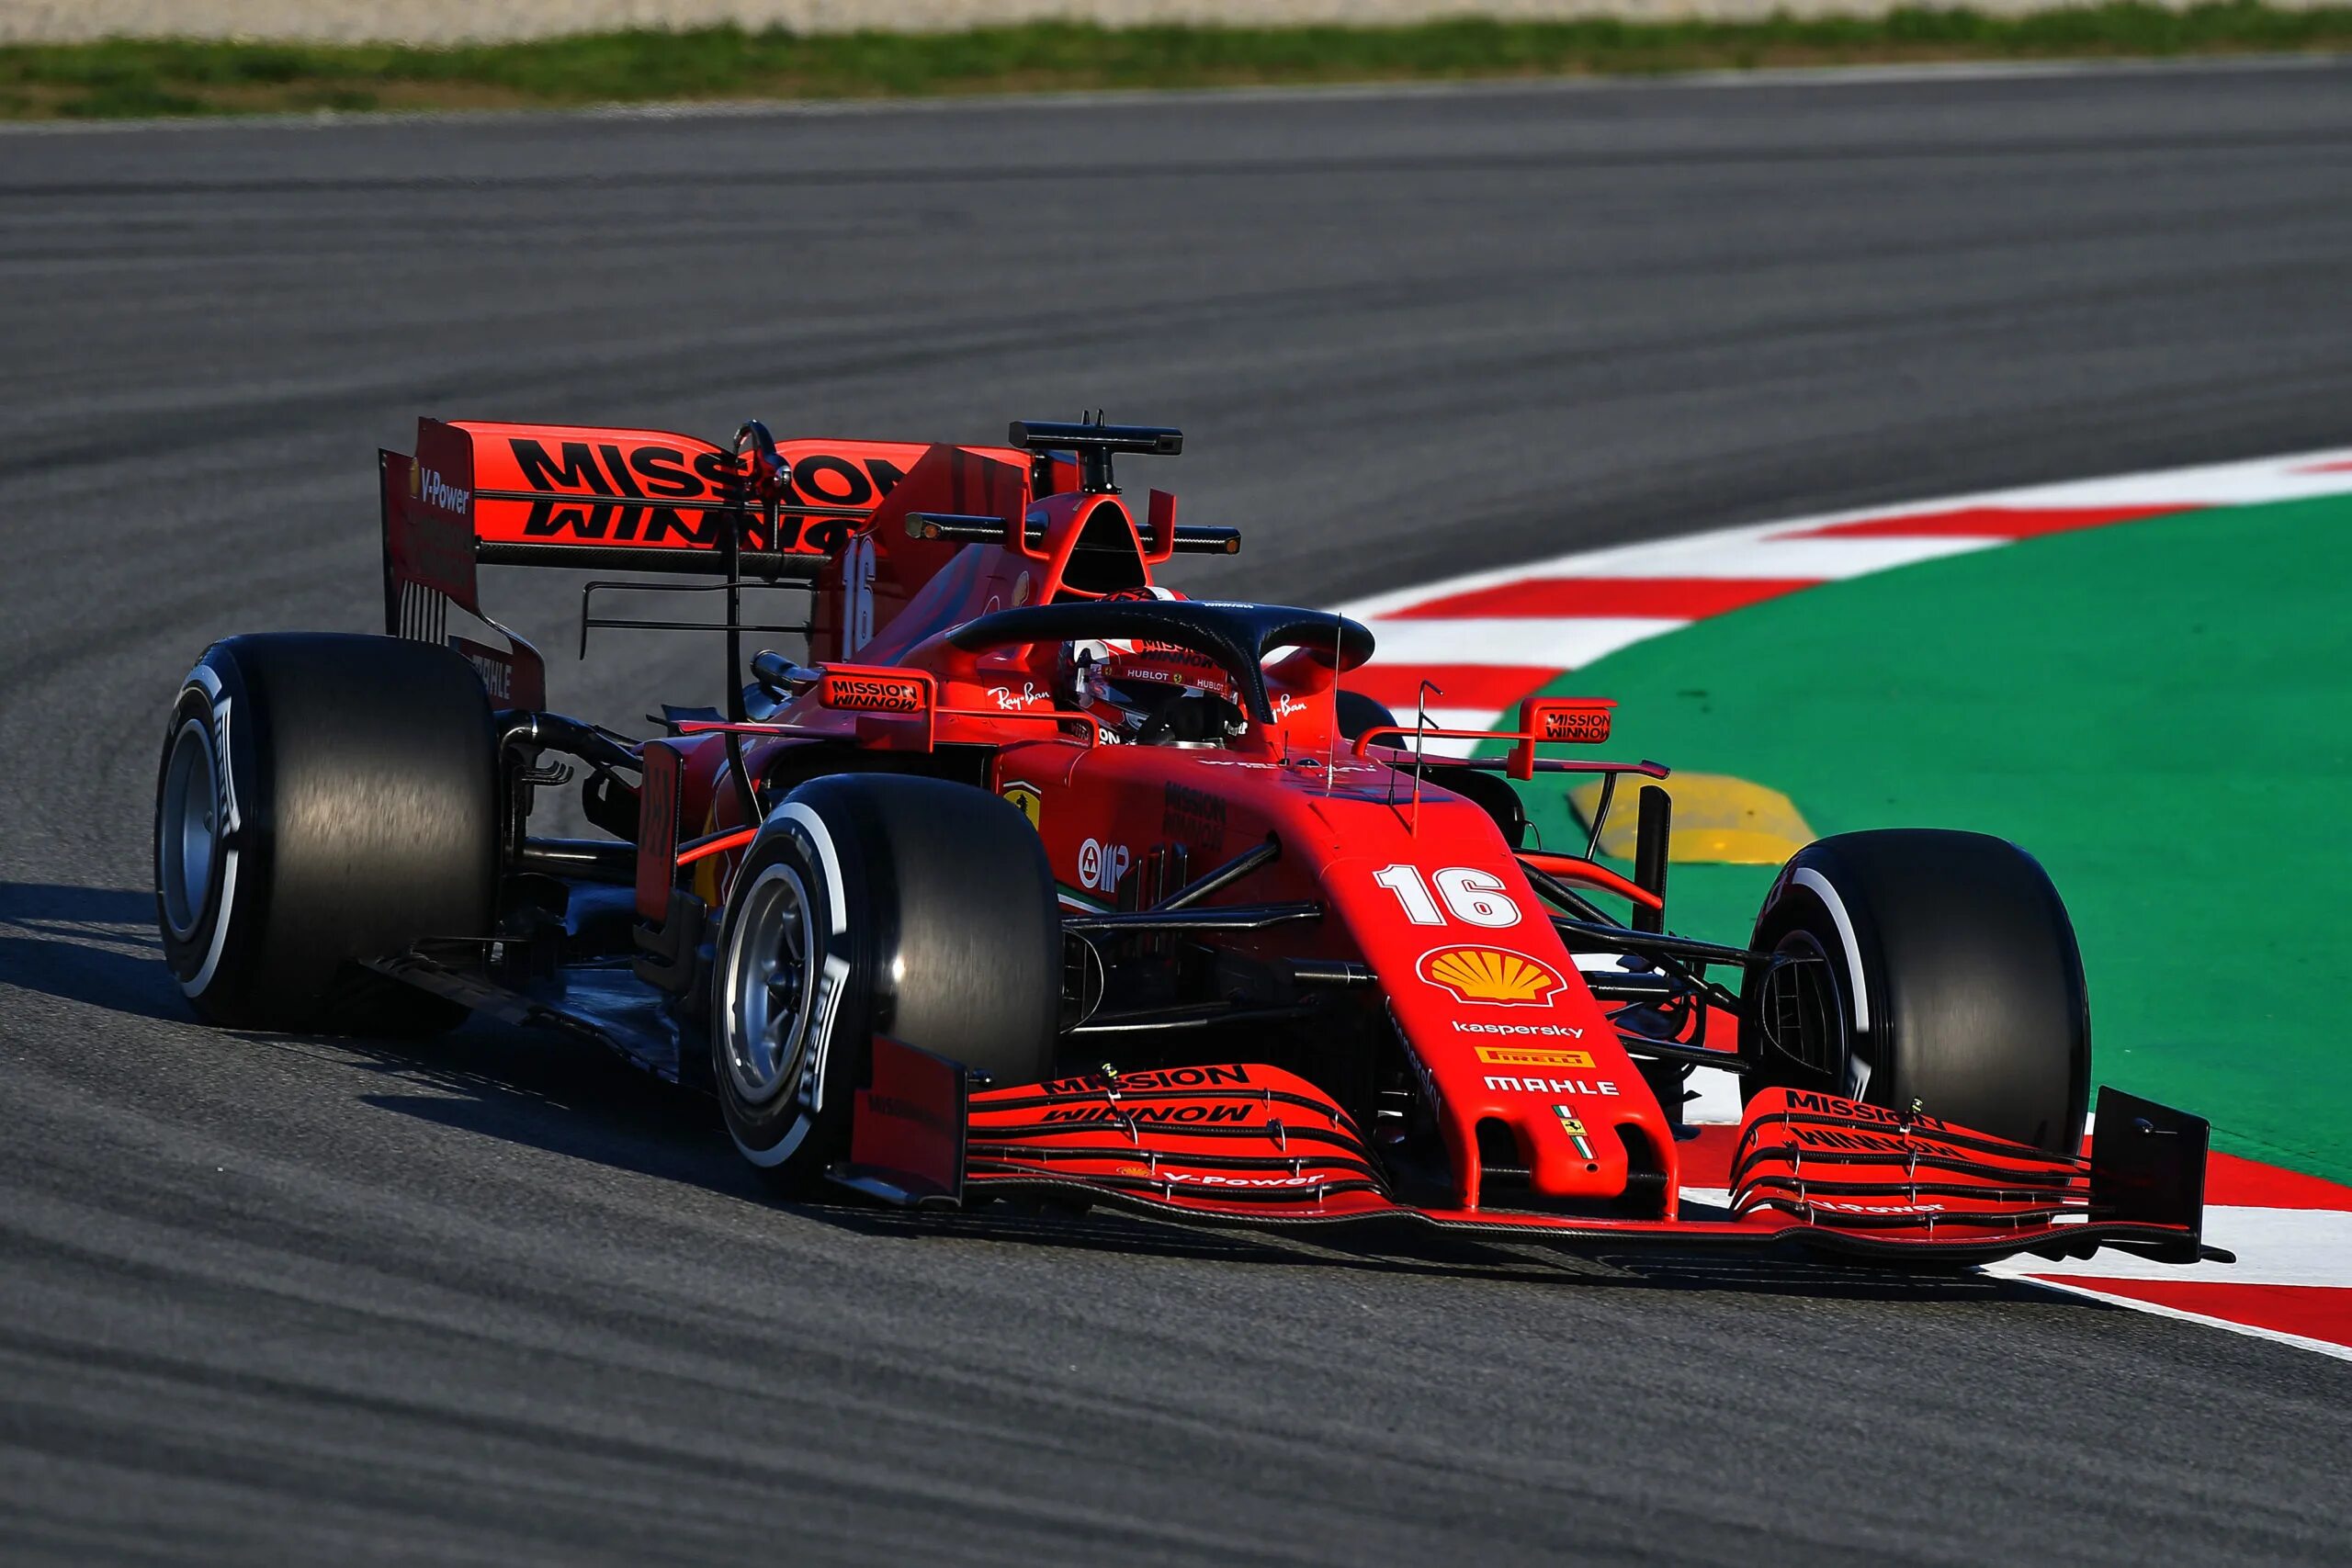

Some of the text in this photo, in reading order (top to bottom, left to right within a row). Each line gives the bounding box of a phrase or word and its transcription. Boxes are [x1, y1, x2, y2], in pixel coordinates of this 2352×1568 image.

[421, 467, 470, 514] V-Power
[842, 534, 876, 663] 16
[1127, 670, 1169, 682] HUBLOT
[831, 681, 917, 698] MISSION
[832, 694, 917, 711] WINNOW
[1546, 714, 1611, 727] MISSION
[1373, 863, 1522, 929] 16
[1452, 1021, 1584, 1039] kaspersky
[1486, 1050, 1583, 1065] PIRELLI
[1483, 1076, 1620, 1096] MAHLE
[1040, 1104, 1253, 1122] WINNOW
[1164, 1171, 1325, 1188] V-Power
